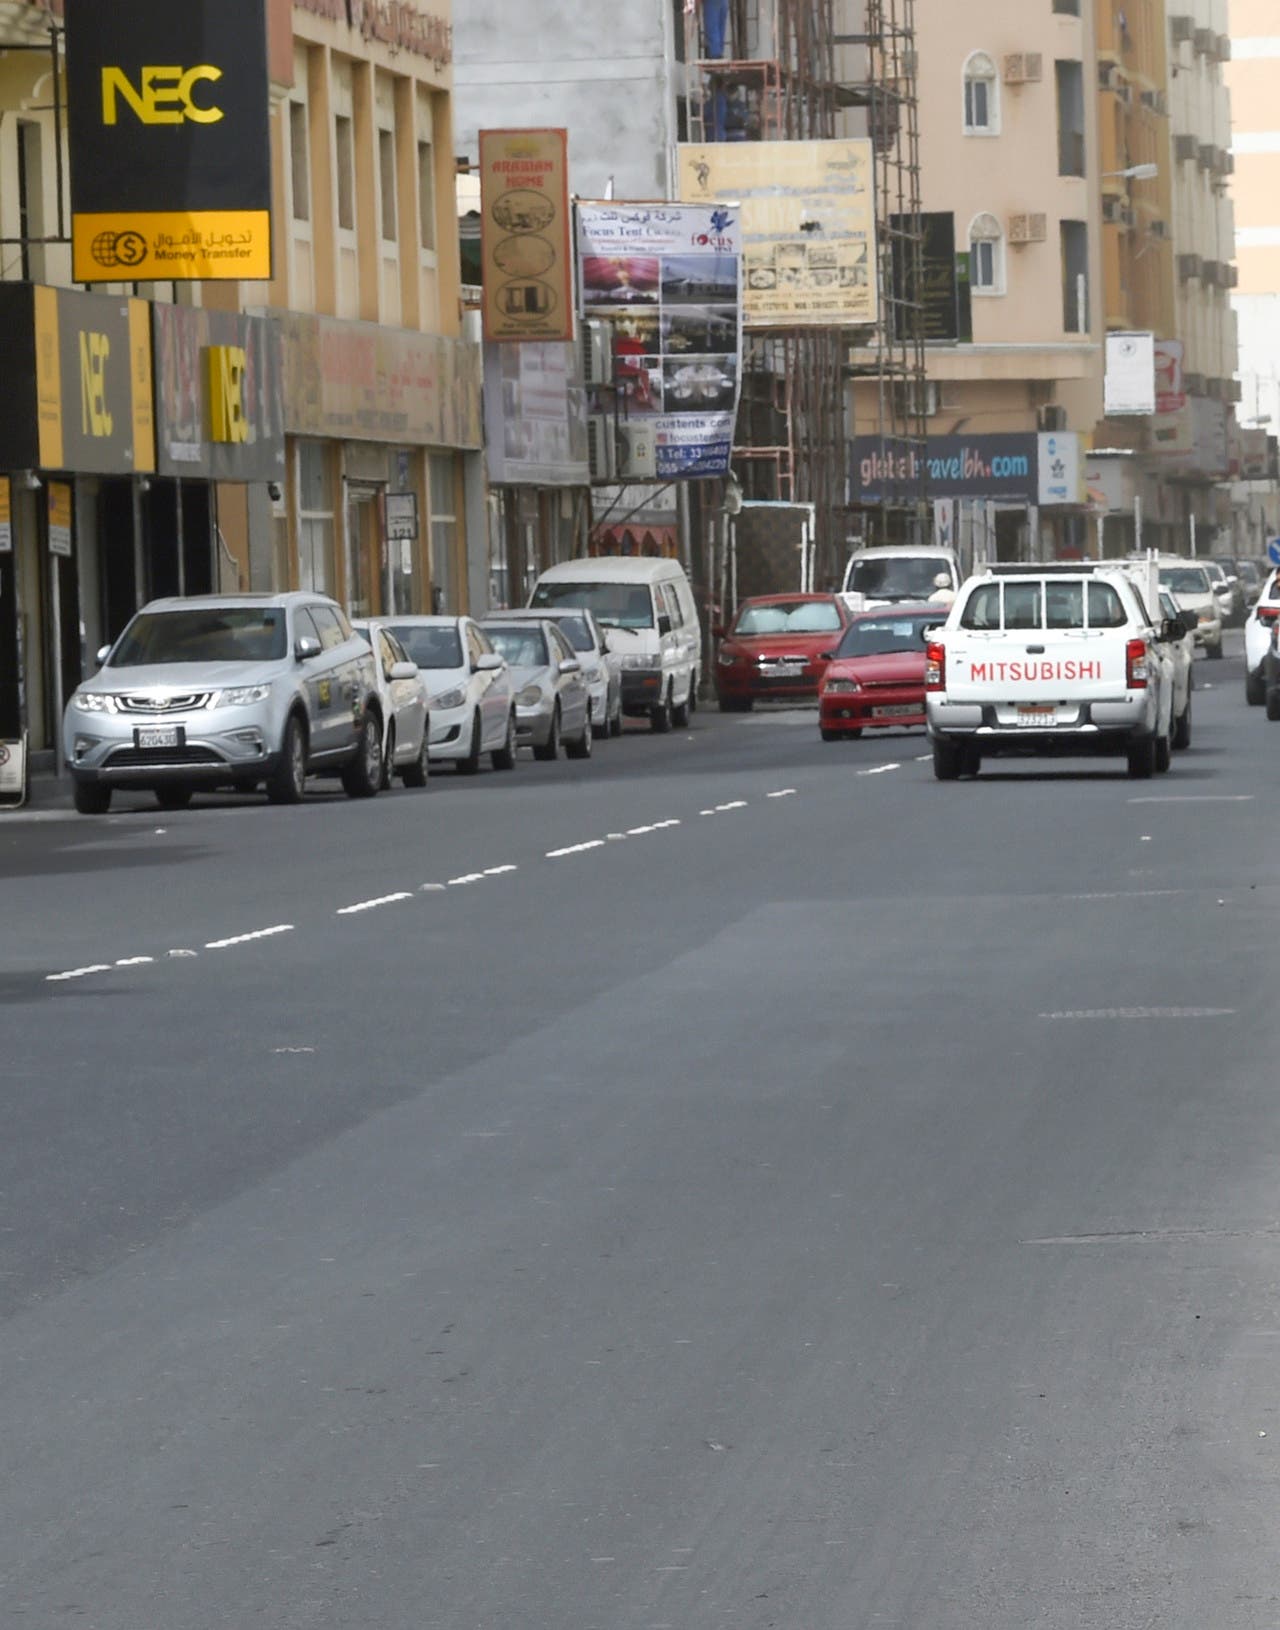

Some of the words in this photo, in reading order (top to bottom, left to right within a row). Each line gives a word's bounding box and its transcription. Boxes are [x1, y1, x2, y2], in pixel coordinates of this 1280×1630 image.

[101, 64, 224, 125] NEC
[153, 228, 202, 249] الأموال
[205, 229, 253, 247] تحويل
[582, 227, 615, 237] Focus
[619, 226, 642, 236] Tent
[691, 233, 733, 246] focus
[154, 249, 196, 261] Money
[200, 247, 252, 259] Transfer
[80, 330, 113, 437] NEC
[971, 661, 1102, 681] MITSUBISHI
